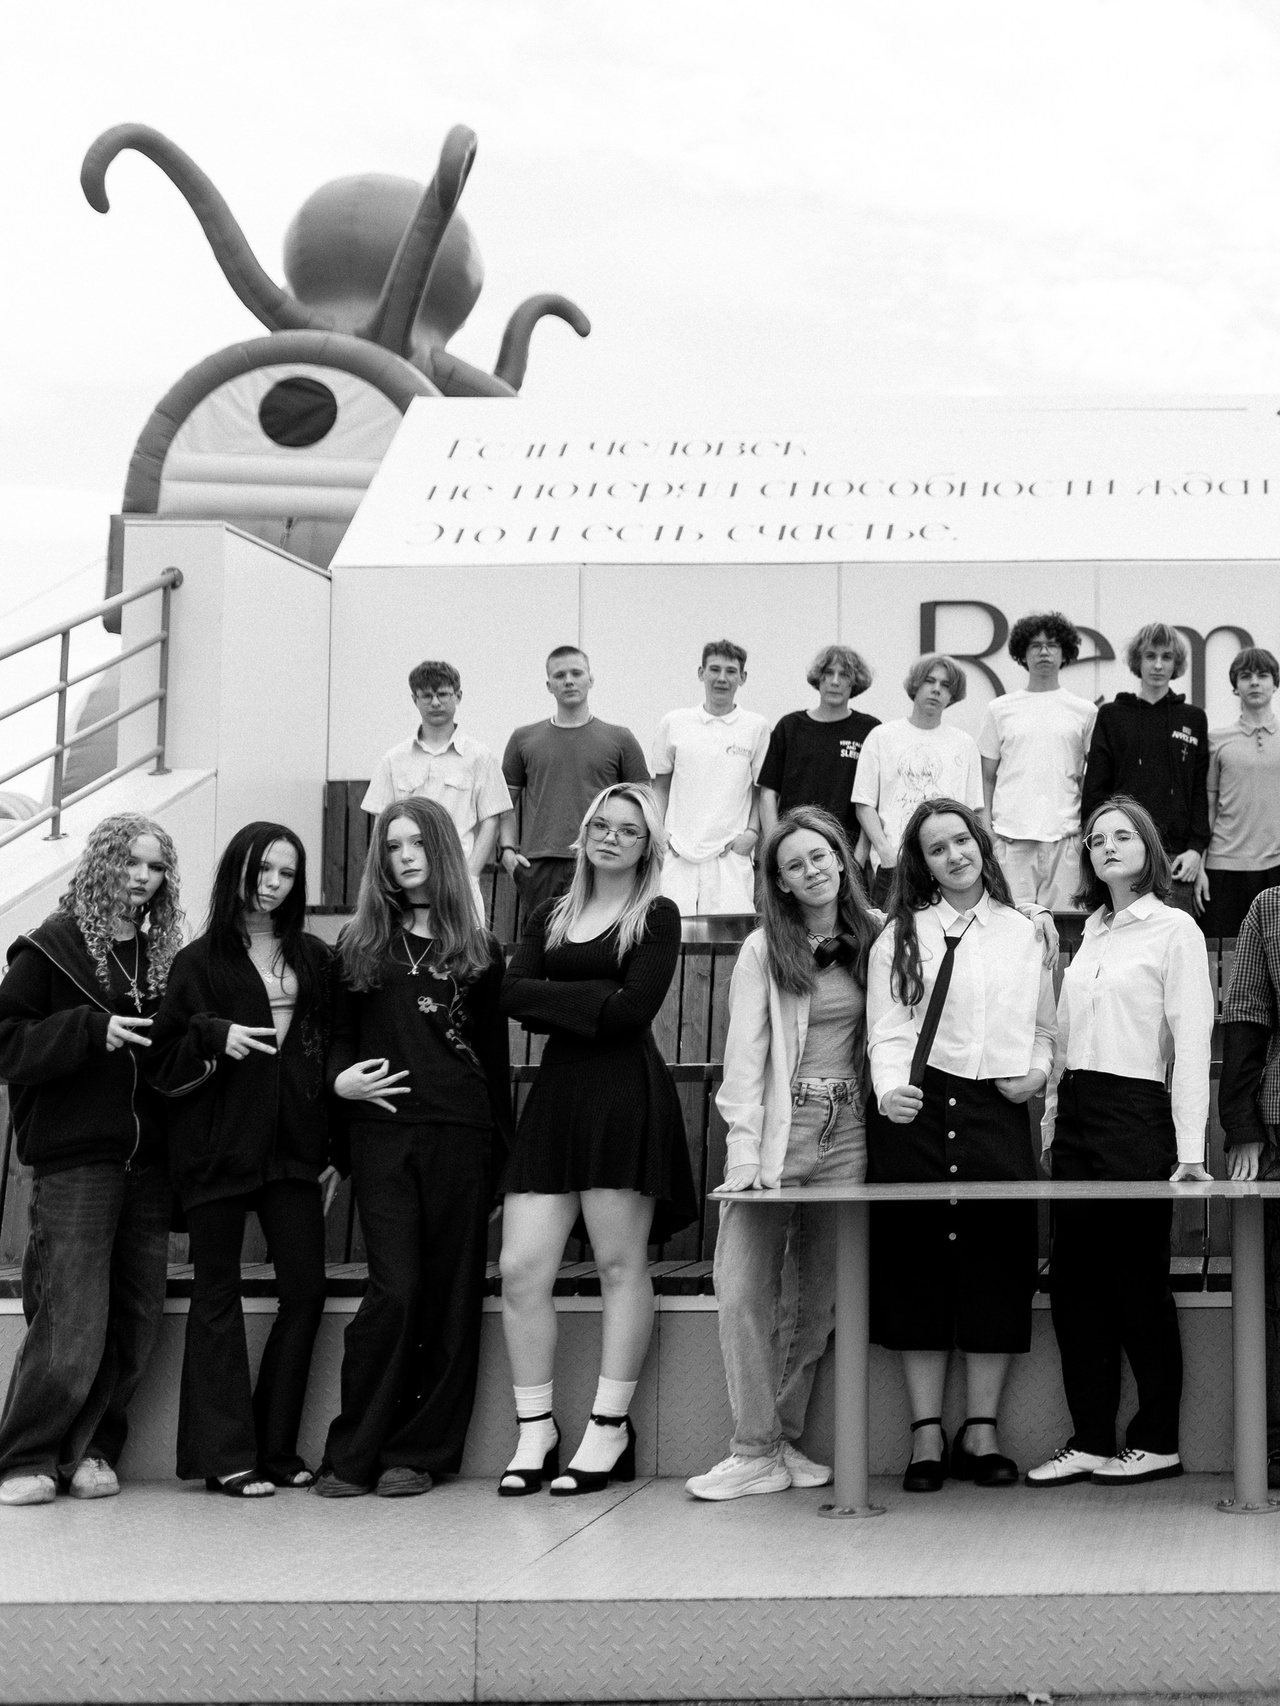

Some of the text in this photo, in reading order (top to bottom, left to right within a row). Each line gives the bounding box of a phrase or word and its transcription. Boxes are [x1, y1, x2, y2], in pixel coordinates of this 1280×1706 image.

[446, 437, 809, 460] Если человек
[425, 482, 494, 502] не
[511, 480, 739, 504] потерял
[758, 471, 1116, 499] способности
[404, 520, 958, 546] Это и есть счастье.
